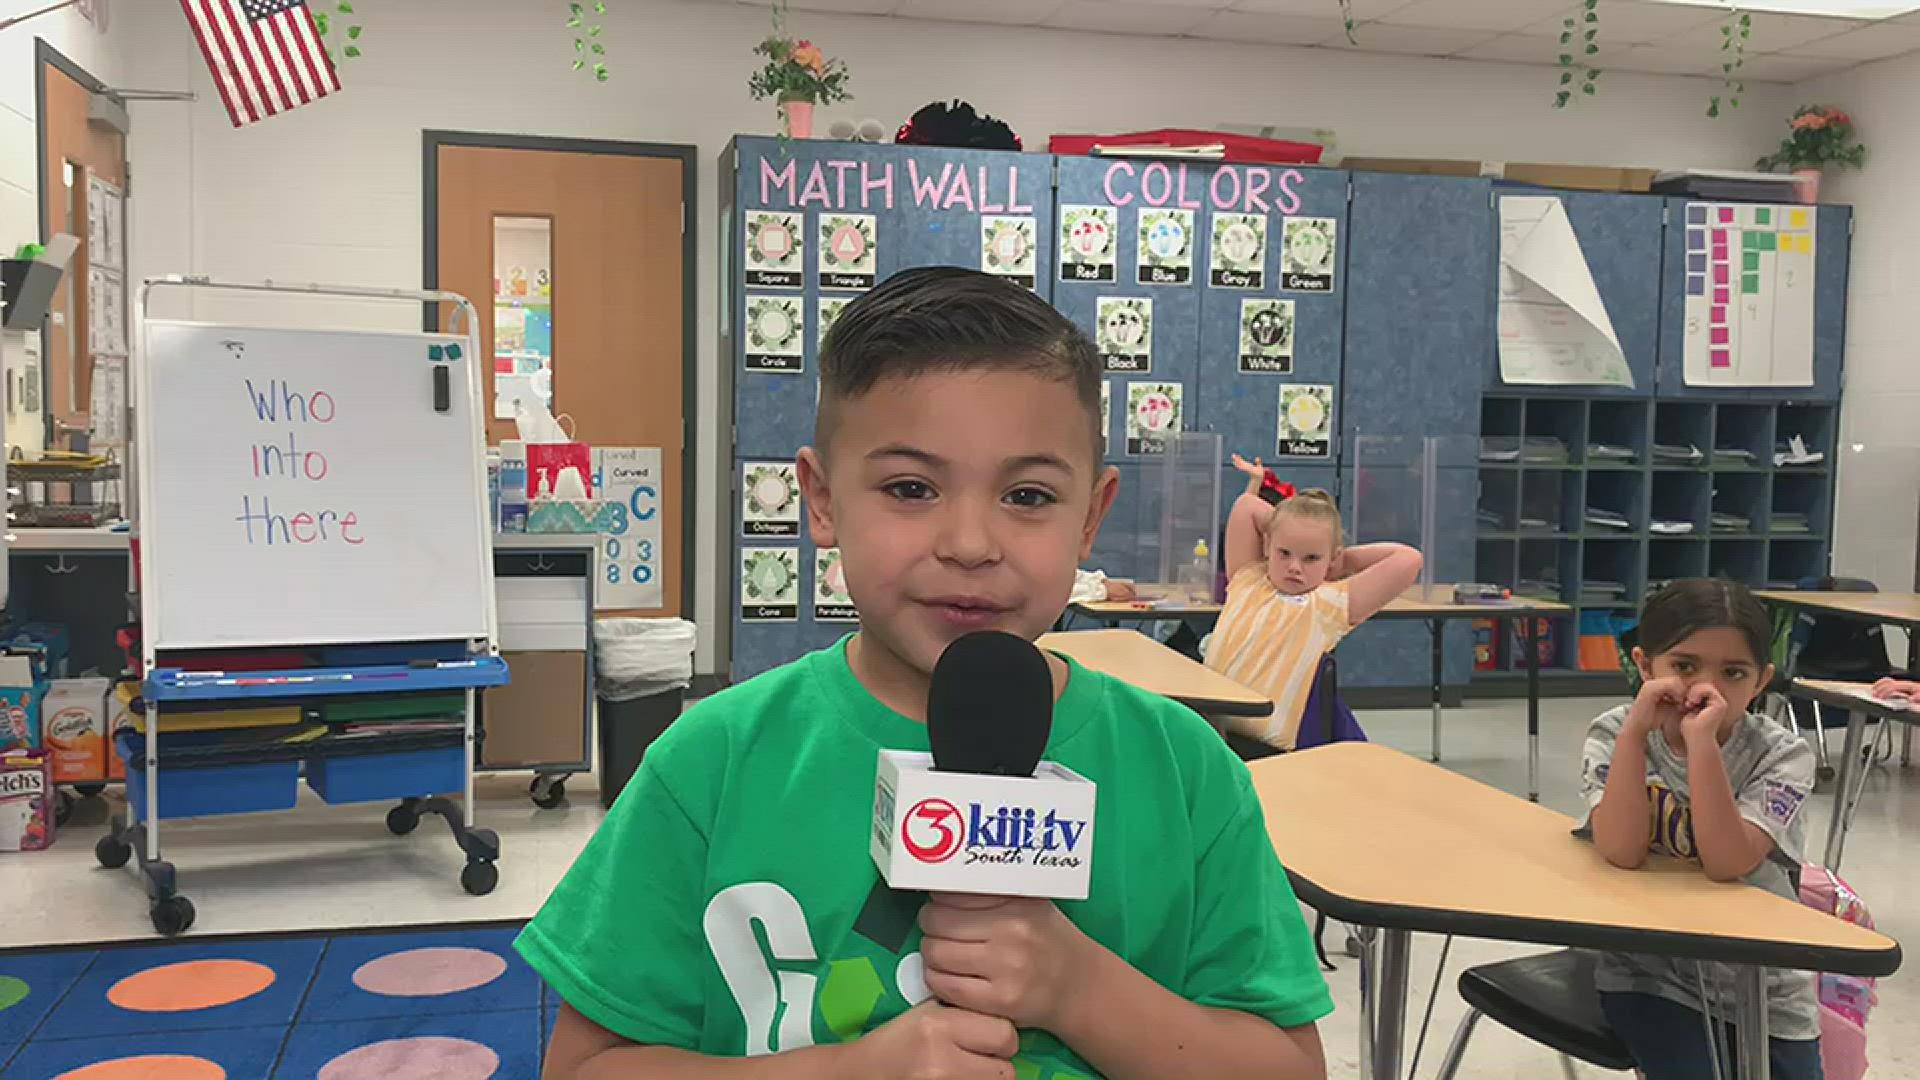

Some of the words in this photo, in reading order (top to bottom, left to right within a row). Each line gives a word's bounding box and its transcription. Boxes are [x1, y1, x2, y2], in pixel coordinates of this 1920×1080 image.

[760, 155, 894, 210] MATH
[906, 158, 1034, 214] WALL
[1103, 161, 1306, 215] COLORS
[758, 272, 790, 285] Square
[1076, 265, 1099, 279] Red
[1152, 267, 1177, 281] Blue
[830, 274, 864, 288] Triangle
[1289, 274, 1323, 288] Green
[760, 356, 787, 366] Circle
[1108, 355, 1138, 369] Black
[1248, 357, 1281, 371] White
[245, 377, 336, 423] Who
[1287, 440, 1321, 455] Yellow
[613, 467, 650, 478] Curved
[631, 485, 656, 520] C
[236, 495, 365, 545] there
[758, 606, 781, 616] Cone
[964, 845, 1025, 866] South
[1033, 846, 1083, 868] Texas
